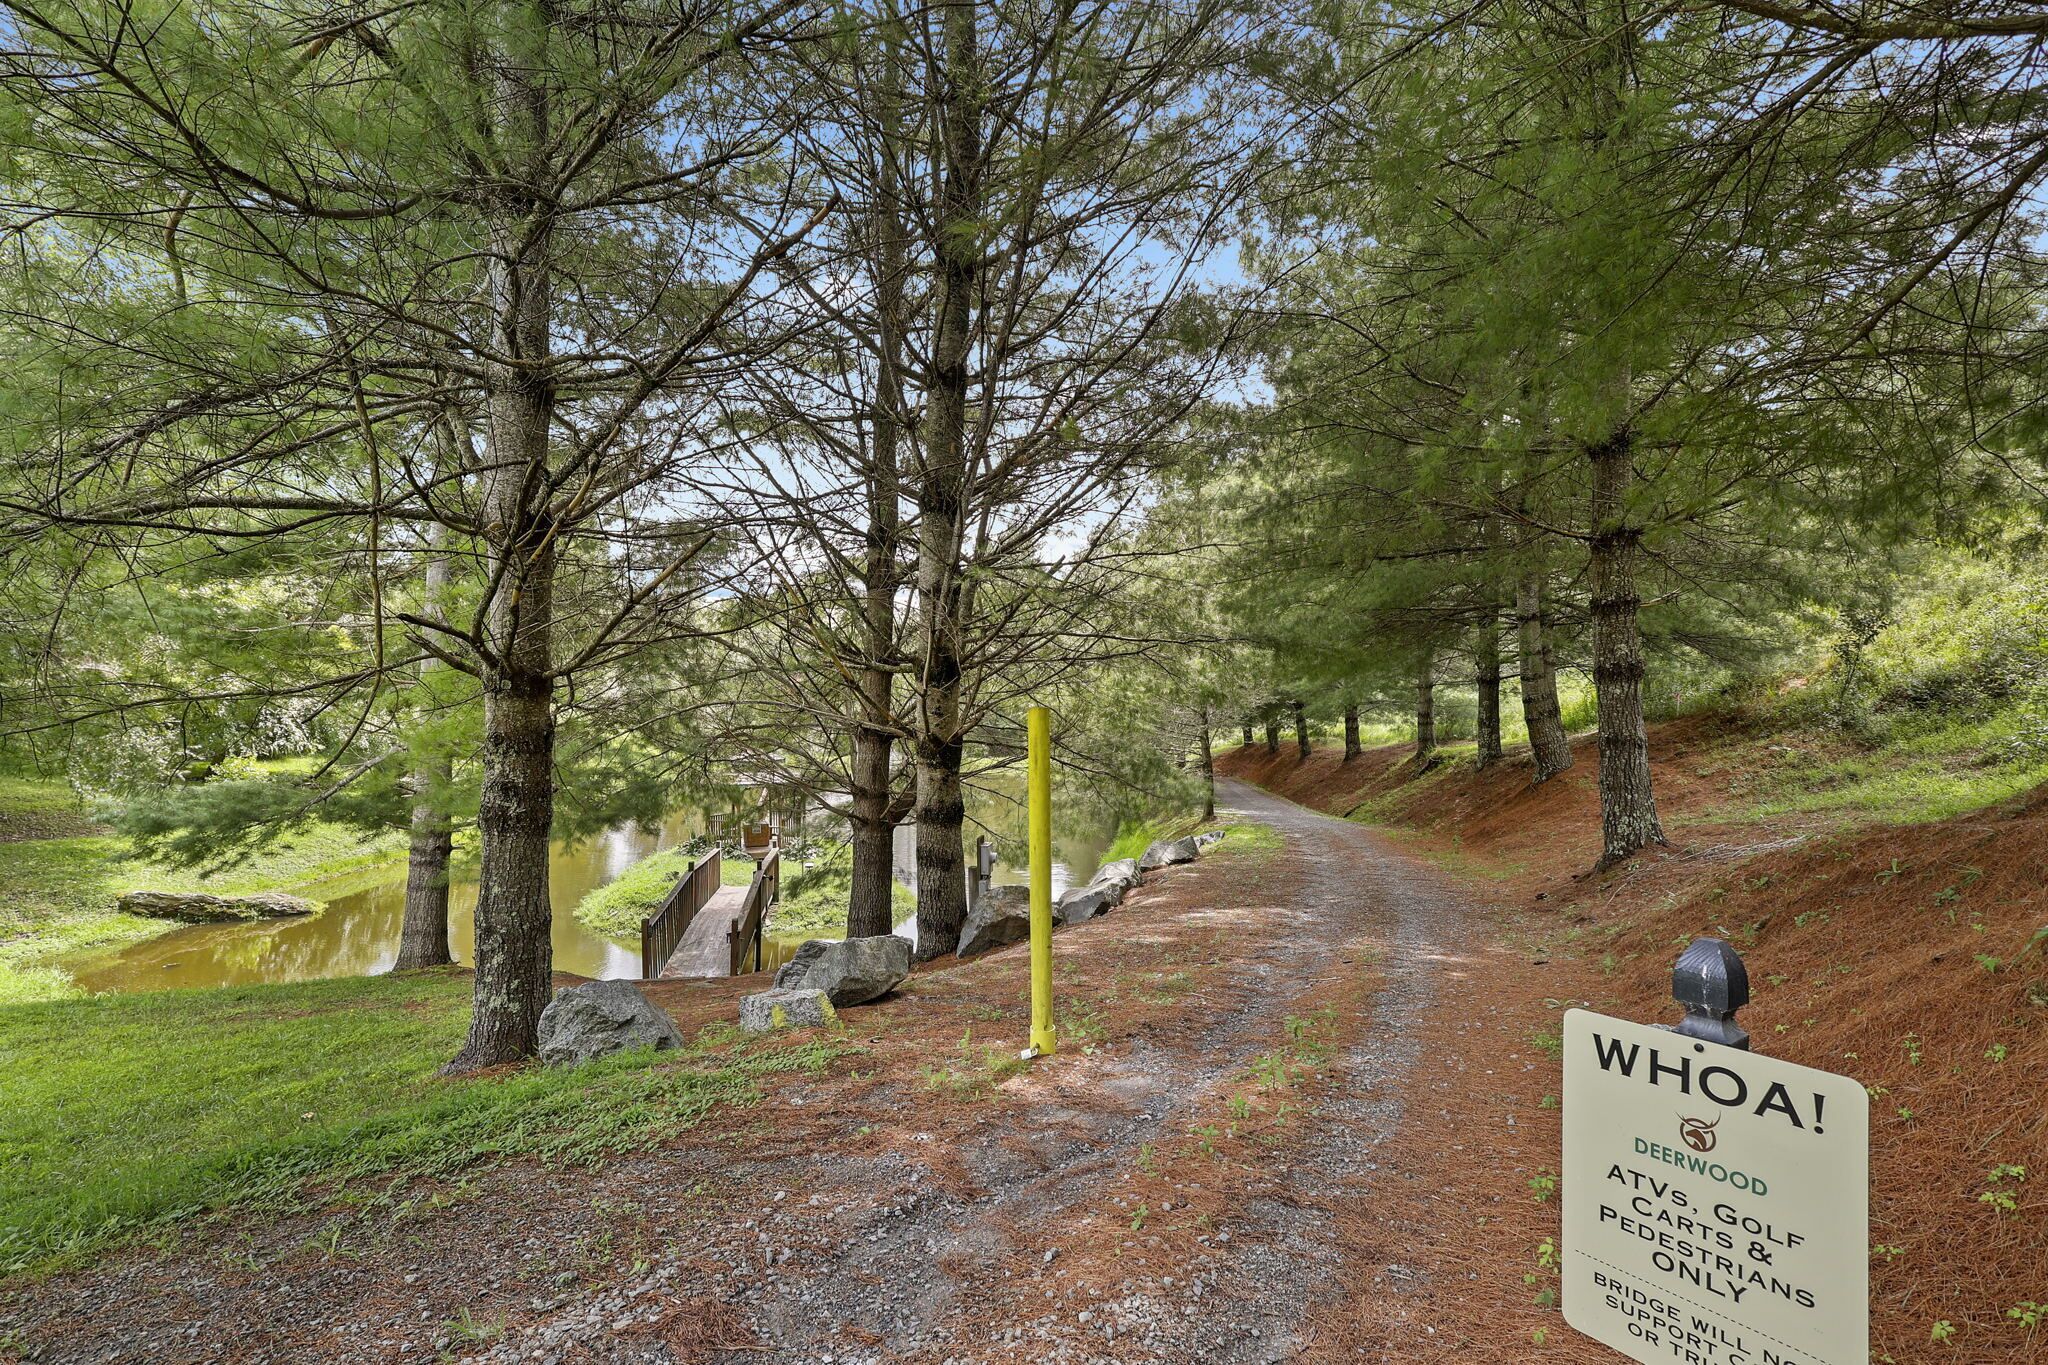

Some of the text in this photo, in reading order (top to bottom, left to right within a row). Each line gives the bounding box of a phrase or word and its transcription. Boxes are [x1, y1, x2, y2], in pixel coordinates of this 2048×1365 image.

[1592, 1032, 1826, 1135] WHOA!
[1634, 1136, 1768, 1196] DEERWOOD
[1599, 1204, 1816, 1309] PEDESTRIANS
[1631, 1196, 1773, 1267] CARTS &
[1713, 1203, 1805, 1249] GOLF
[1651, 1251, 1748, 1304] ONLY
[1594, 1271, 1681, 1323] BRIDGE
[1691, 1315, 1752, 1356] WILL
[1605, 1294, 1718, 1356] SUPPORT
[1627, 1322, 1659, 1347] OR
